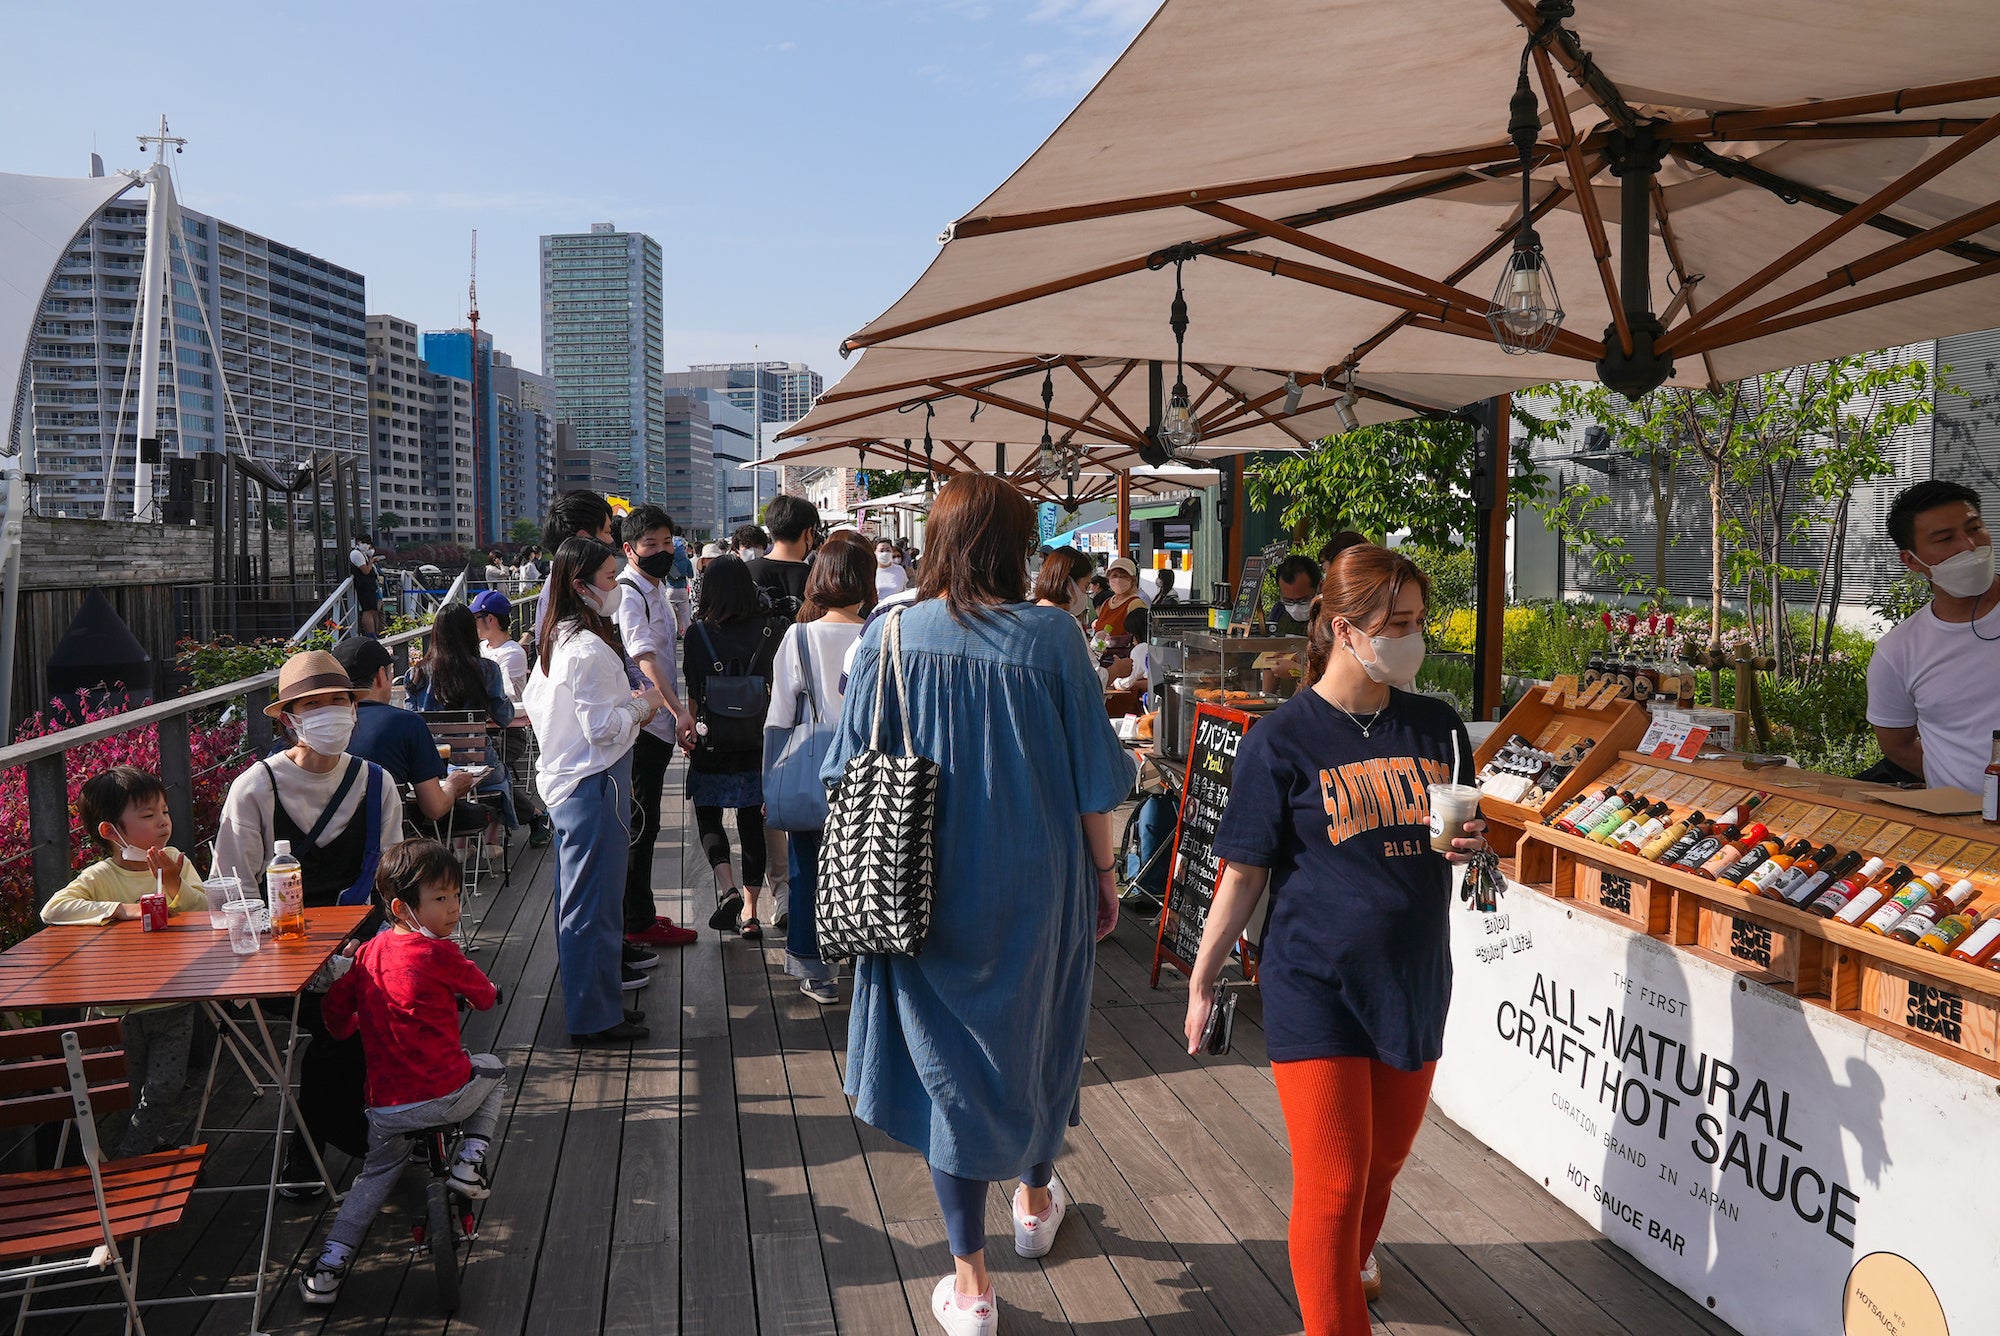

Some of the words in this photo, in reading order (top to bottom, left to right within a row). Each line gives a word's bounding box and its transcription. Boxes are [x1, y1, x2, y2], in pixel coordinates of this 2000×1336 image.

[1319, 757, 1430, 846] SANDWICH
[1383, 839, 1422, 858] 21.6.1
[1483, 913, 1510, 935] Enjoy
[1509, 930, 1533, 954] Life!
[1613, 972, 1633, 994] THE
[1640, 987, 1688, 1017] FIRST
[1529, 972, 1803, 1152] ALL-NATURAL
[1497, 1000, 1596, 1090] CRAFT
[1599, 1061, 1680, 1140] HOT
[1691, 1113, 1860, 1249] SAUCE
[1551, 1092, 1597, 1137] CURATION
[1603, 1132, 1647, 1168] BRAND
[1659, 1163, 1678, 1186] IN
[1690, 1182, 1739, 1222] JAPAN
[1567, 1162, 1590, 1192] HOT
[1593, 1184, 1643, 1230] SAUCE
[1648, 1219, 1686, 1256] BAR
[1855, 1287, 1903, 1336] HOTSAUCE
[1893, 1311, 1906, 1328] WEB
